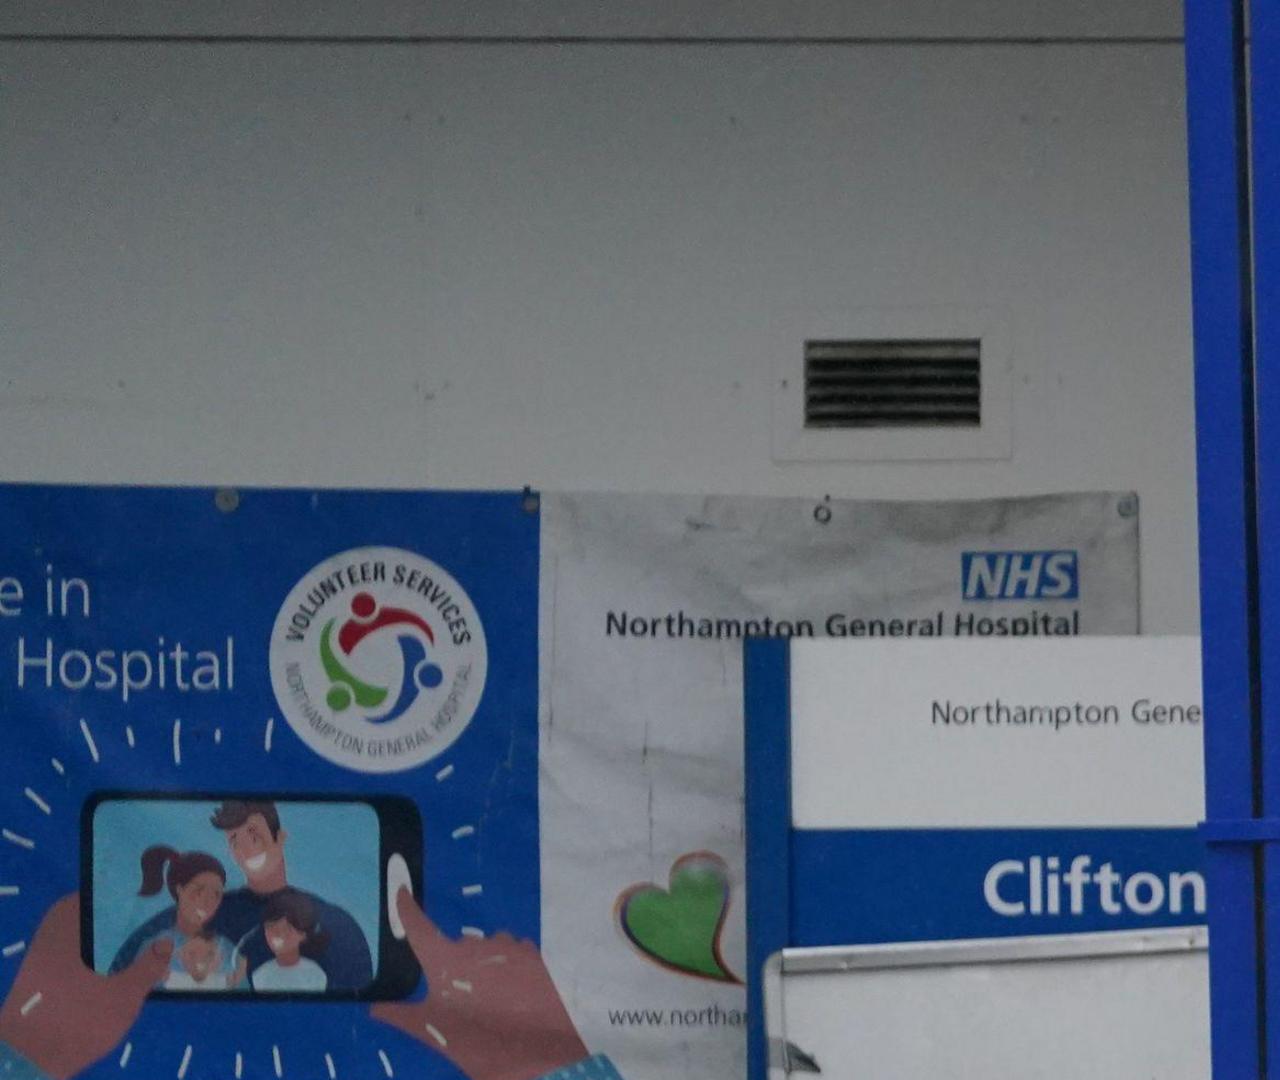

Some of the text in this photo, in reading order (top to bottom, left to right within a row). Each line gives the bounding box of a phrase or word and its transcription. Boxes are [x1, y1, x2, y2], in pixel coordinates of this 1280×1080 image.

[0, 562, 91, 615] e in
[966, 554, 1076, 598] NHS
[286, 561, 471, 646] VOLUNTEER SERVICES
[605, 610, 1079, 637] Northampton General Hospital
[18, 636, 234, 700] Hospital
[286, 661, 473, 757] NORTHAMPTON GENERAL HOSPITAL
[931, 698, 1201, 731] Northampton Gene
